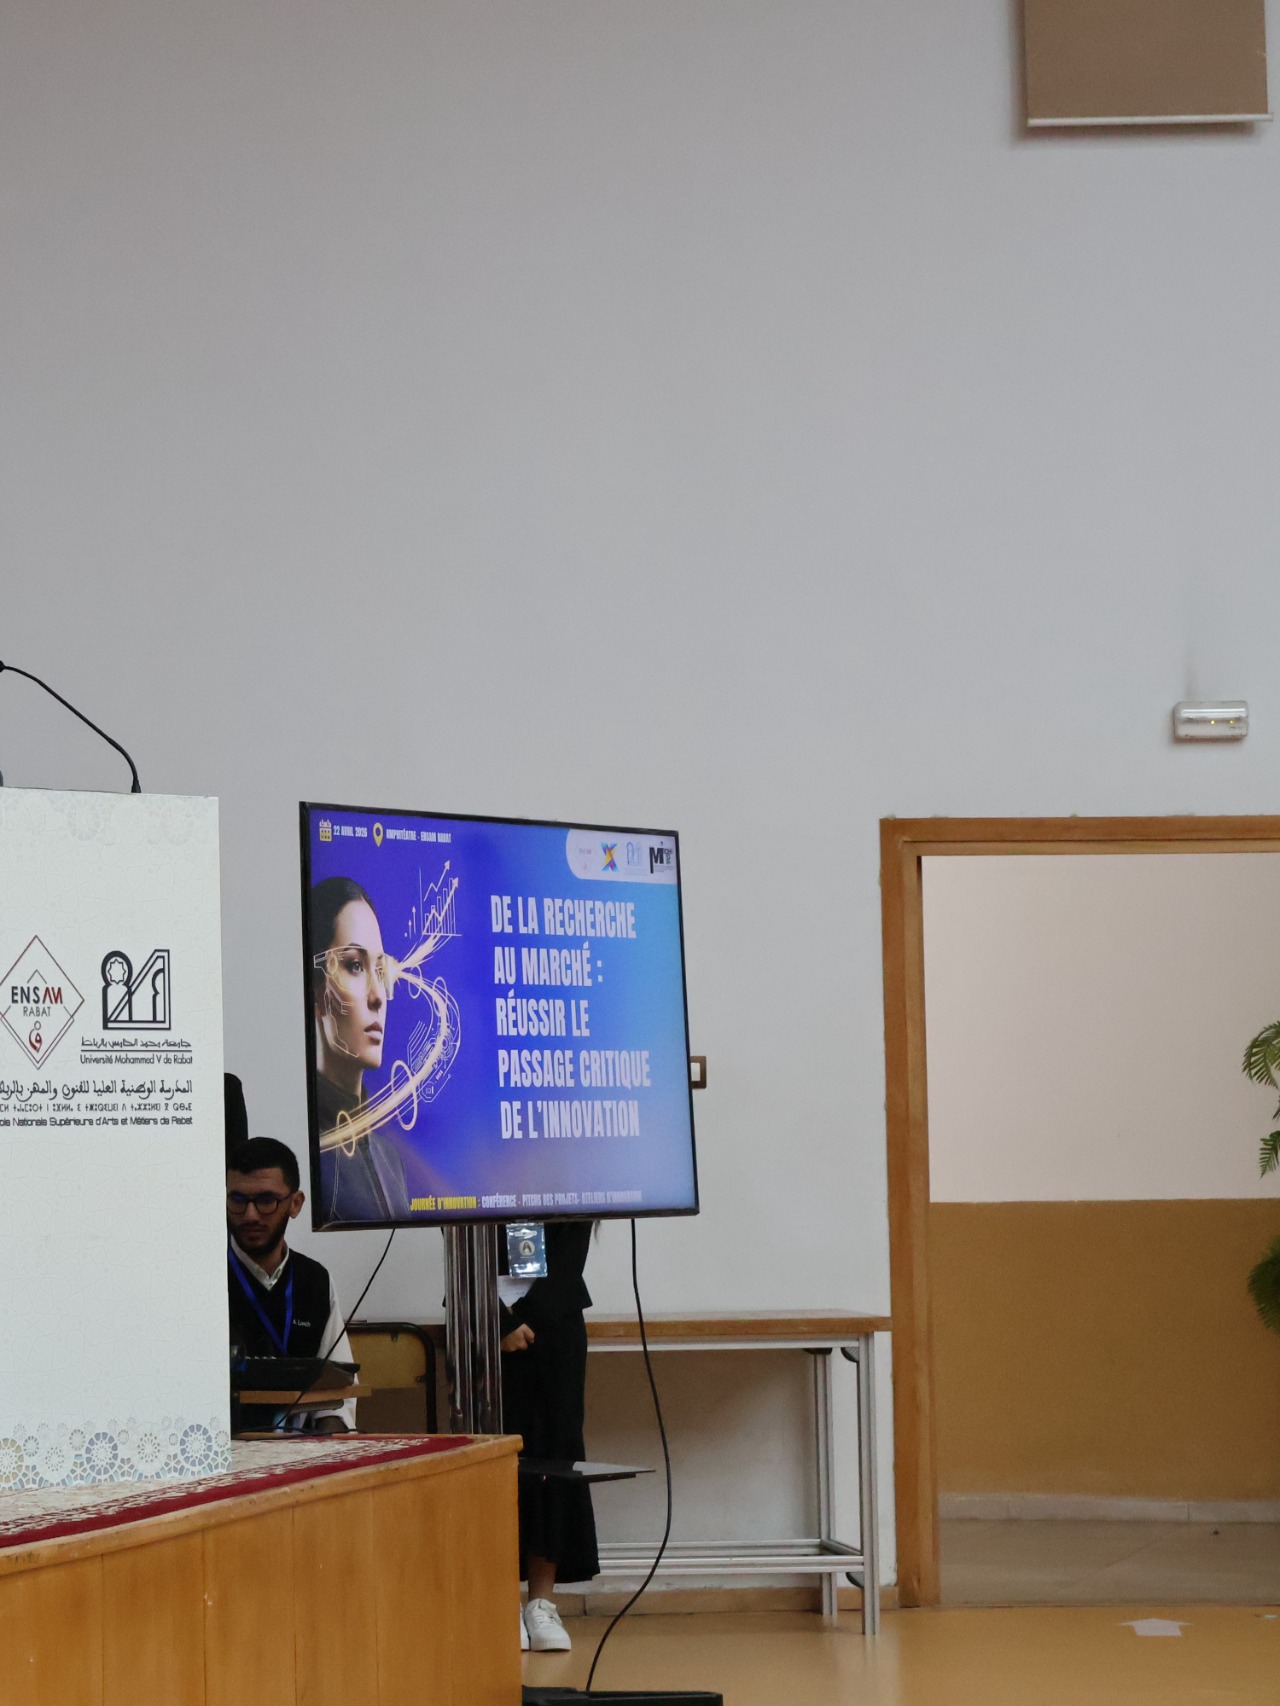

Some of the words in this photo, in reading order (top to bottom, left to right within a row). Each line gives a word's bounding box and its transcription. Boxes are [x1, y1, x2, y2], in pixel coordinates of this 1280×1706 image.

[333, 825, 340, 836] 22
[490, 895, 513, 933] DE
[517, 896, 539, 935] LA
[543, 898, 637, 938] RECHERCHE
[494, 946, 517, 985] AU
[521, 941, 592, 986] MARCHÉ
[23, 1006, 51, 1017] RABAT
[496, 988, 566, 1036] RÉUSSIR
[570, 999, 590, 1037] LE
[80, 1053, 113, 1065] Université
[115, 1053, 154, 1064] Mohammed
[156, 1054, 162, 1064] V
[163, 1053, 172, 1064] de
[174, 1053, 193, 1064] Rabat
[498, 1049, 575, 1088] PASSAGE
[579, 1050, 651, 1090] CRITIQUE
[16, 1080, 57, 1102] والمهن
[62, 1080, 90, 1100] للفنون
[93, 1080, 117, 1096] العليا
[120, 1080, 156, 1100] الوطنية
[160, 1080, 192, 1100] المدرسة
[13, 1117, 47, 1127] Nationale
[49, 1117, 93, 1127] Supérieure
[96, 1116, 118, 1126] d'Arts
[120, 1117, 128, 1126] et
[130, 1116, 158, 1125] Métiers
[160, 1116, 169, 1125] de
[171, 1115, 193, 1125] Rabat
[500, 1101, 523, 1139] DE
[481, 1192, 517, 1209] CONFÉRENCE
